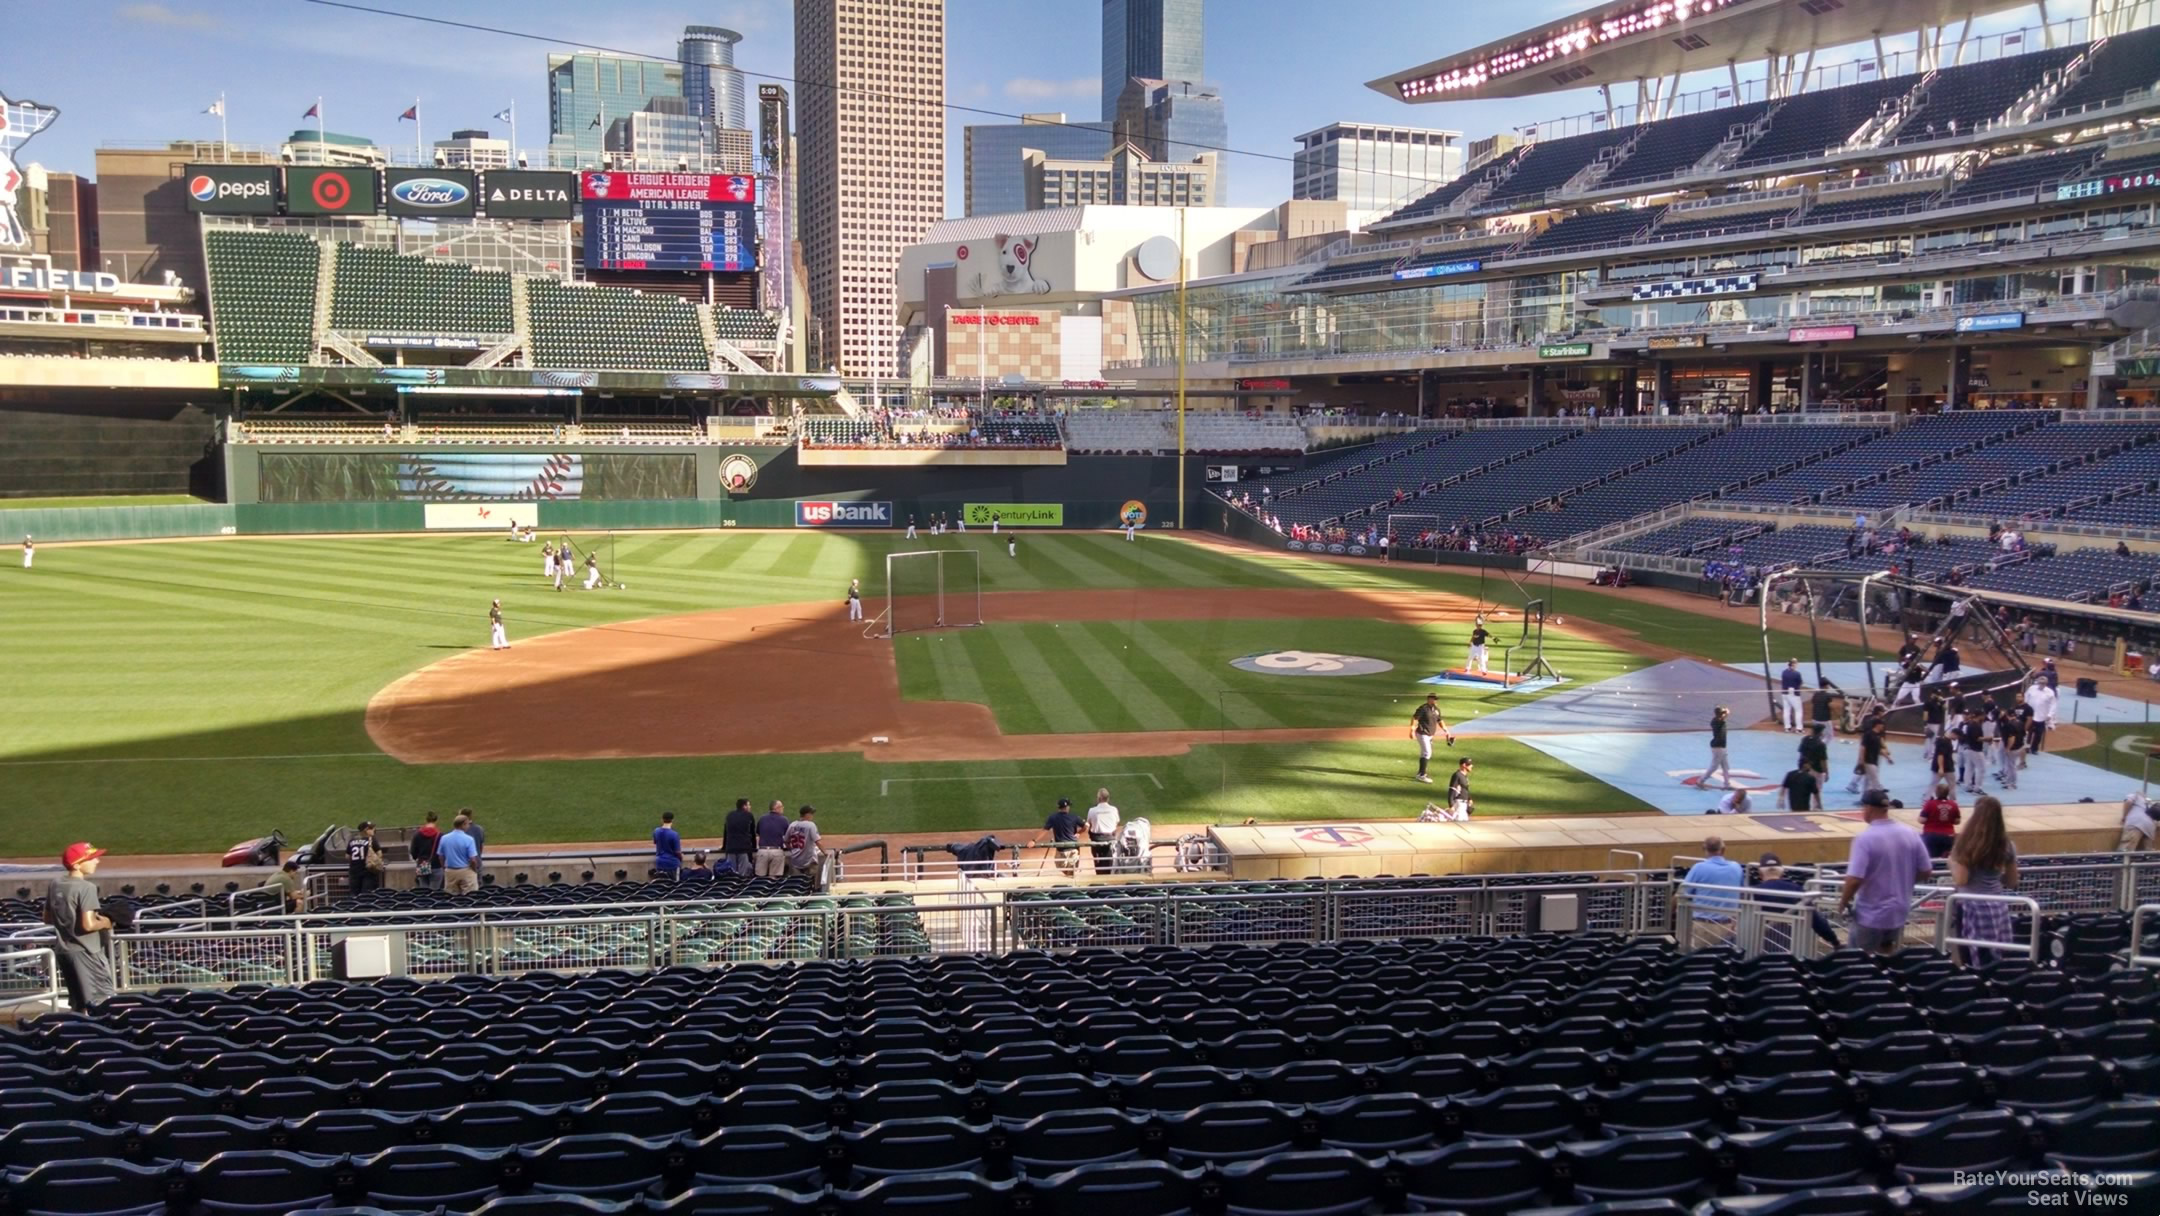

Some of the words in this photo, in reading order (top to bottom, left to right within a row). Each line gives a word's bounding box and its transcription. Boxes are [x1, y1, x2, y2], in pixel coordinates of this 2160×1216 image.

[628, 174, 664, 186] LEAGUE
[666, 175, 710, 187] LEADERS
[219, 180, 270, 198] pepsi
[407, 183, 453, 202] Ford
[630, 188, 674, 200] AMERICAN
[676, 189, 709, 200] LEAGUE
[510, 189, 568, 201] DELTA
[639, 200, 669, 209] TOTAL
[671, 201, 701, 210] BASES
[622, 209, 643, 217] BETTS
[622, 218, 647, 226] ALTUVE
[622, 226, 654, 235] MACHADO
[700, 228, 712, 236] BAL
[700, 236, 713, 244] SEA
[623, 244, 662, 252] DONALDSON
[701, 245, 713, 253] TOR
[623, 252, 656, 261] LONGORIA
[703, 253, 711, 261] TB
[11, 267, 120, 293] FIELD
[1664, 290, 1673, 298] 22
[952, 315, 987, 324] TARGET
[1000, 316, 1039, 325] CENTER
[351, 846, 364, 860] 21
